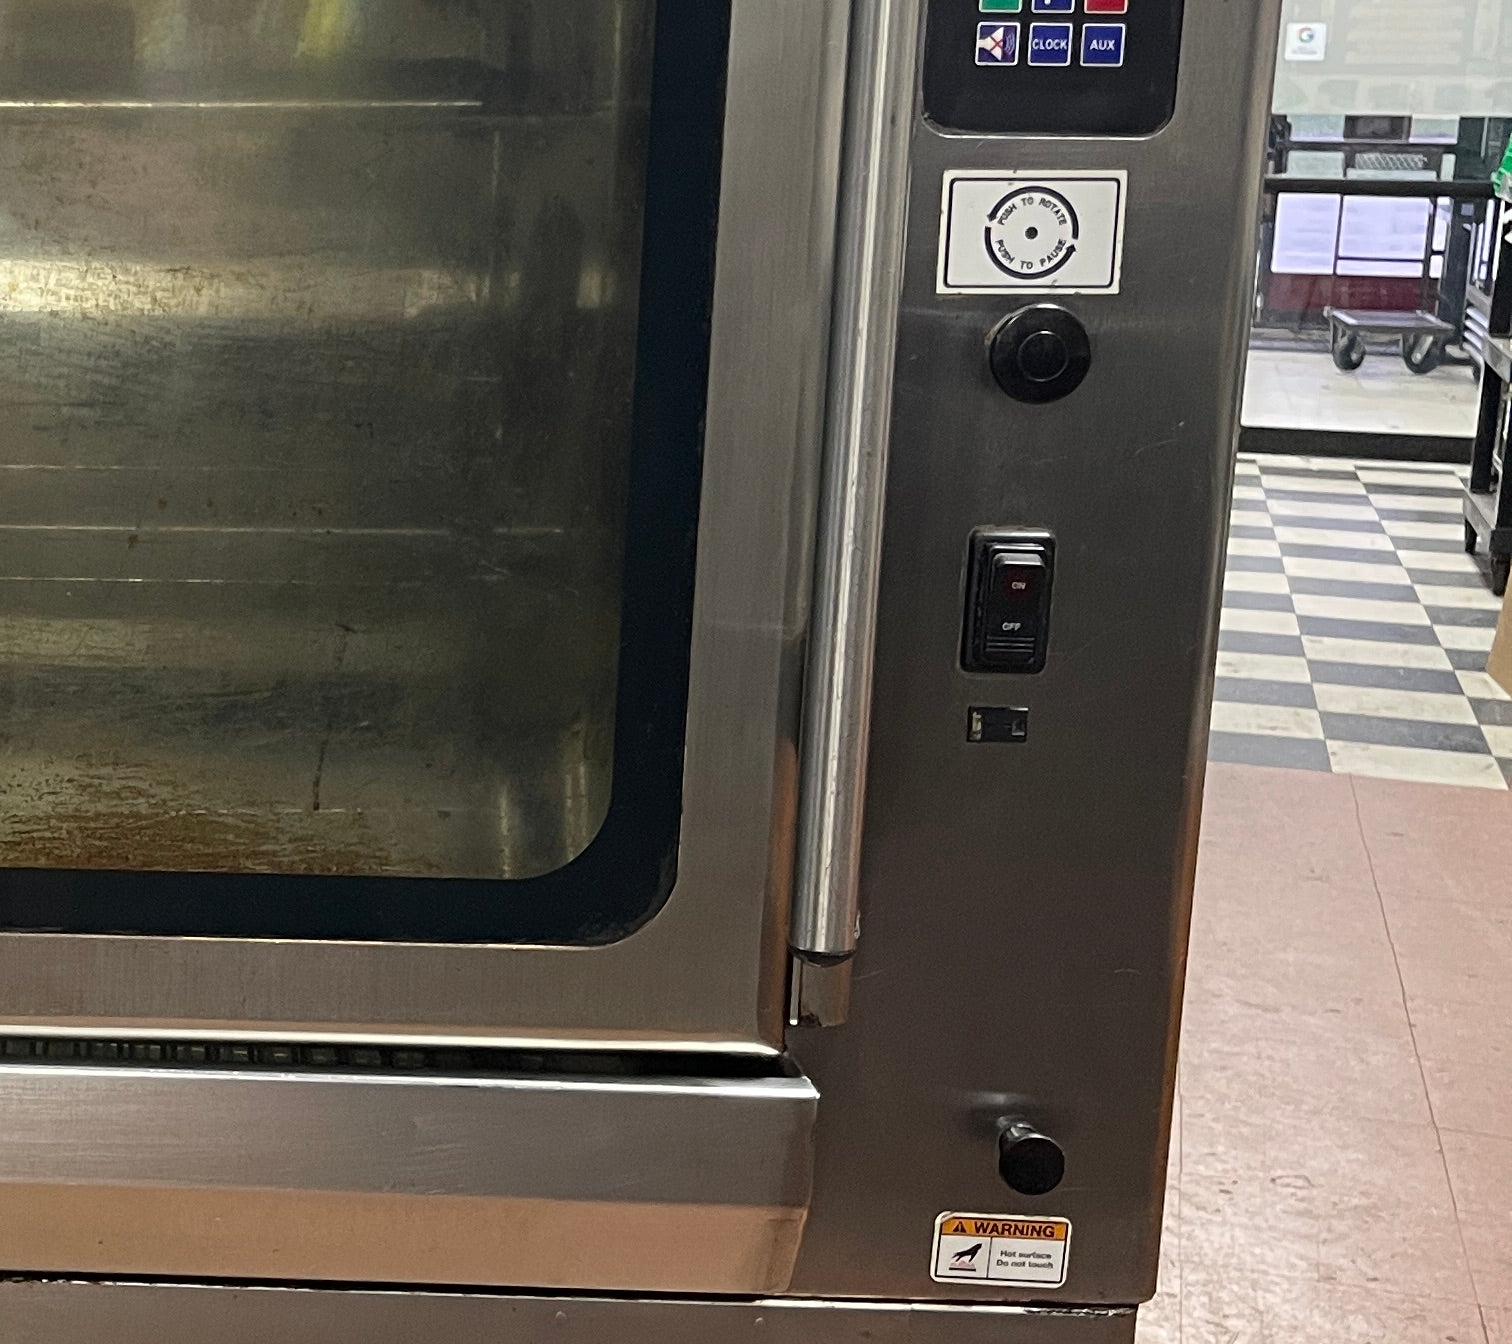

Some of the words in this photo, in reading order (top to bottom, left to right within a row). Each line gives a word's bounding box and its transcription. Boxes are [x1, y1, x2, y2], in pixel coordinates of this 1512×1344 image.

[1032, 38, 1068, 50] CLOCK
[1089, 39, 1116, 51] AUX
[997, 203, 1018, 226] PUSH
[1021, 196, 1034, 206] TO
[1038, 197, 1068, 226] ROTATE
[995, 239, 1016, 264] PUSH
[1020, 261, 1033, 270] TO
[1039, 238, 1067, 267] PAUSE
[974, 1221, 1055, 1238] WARNING
